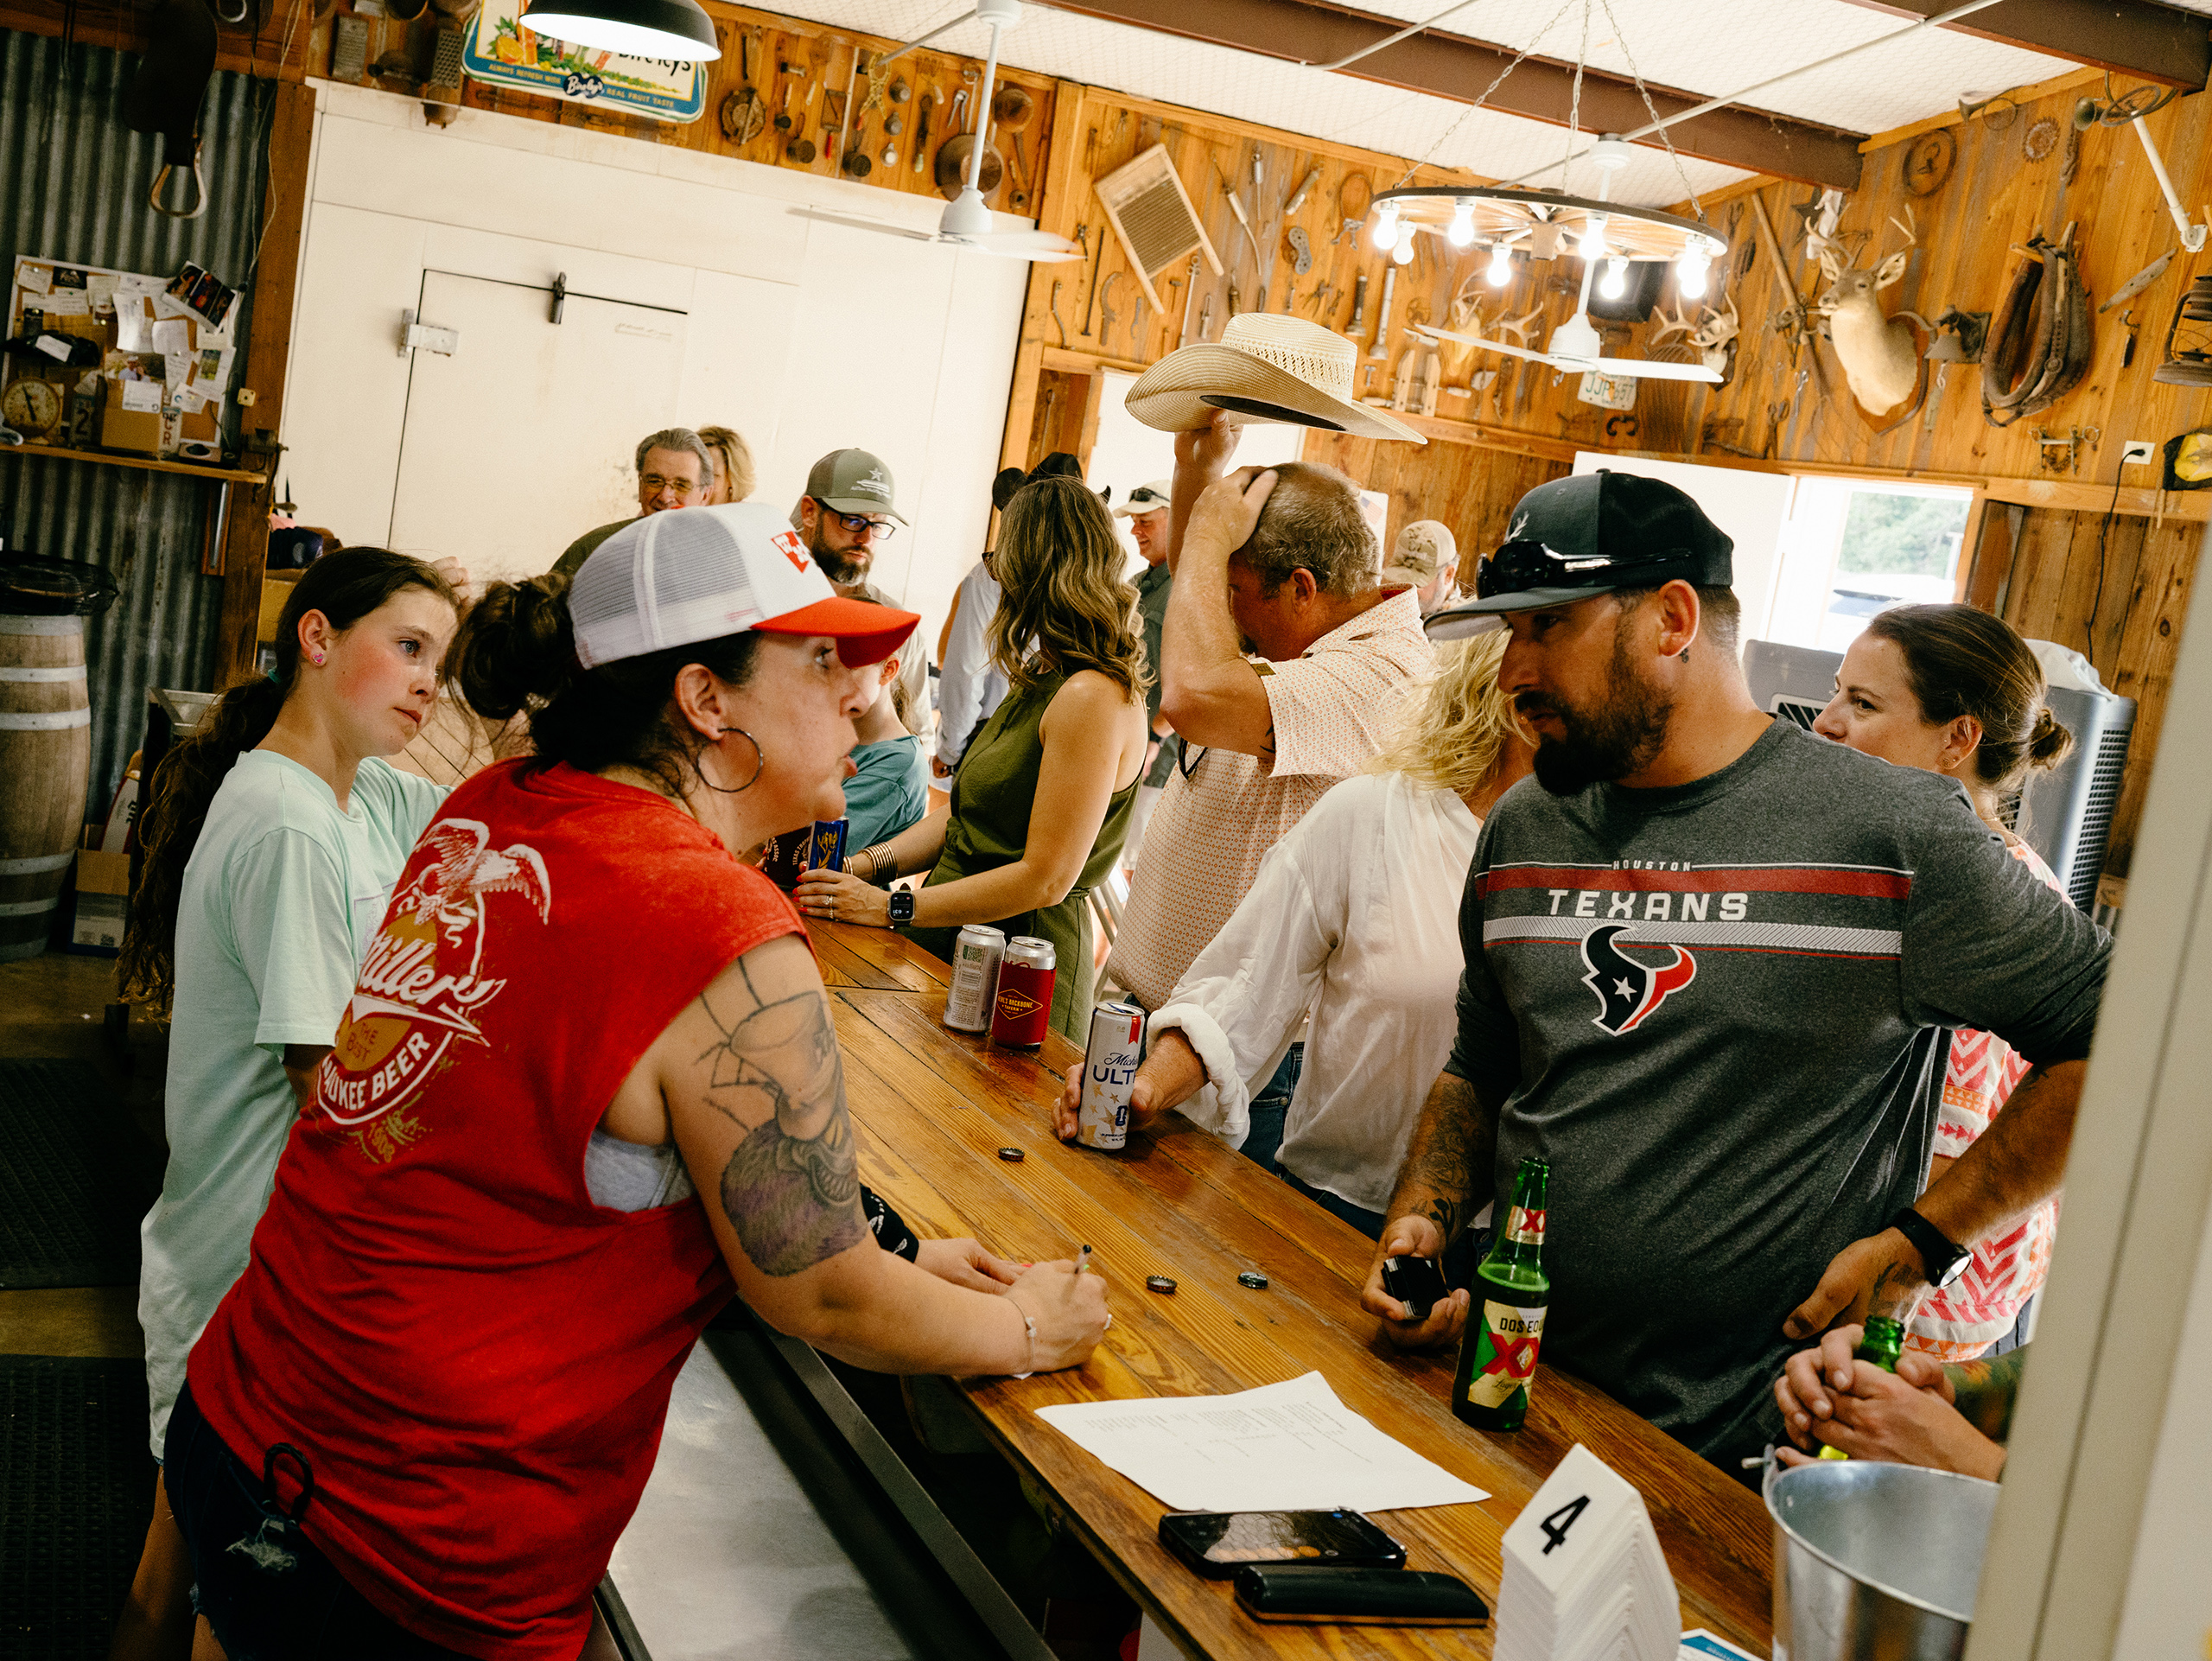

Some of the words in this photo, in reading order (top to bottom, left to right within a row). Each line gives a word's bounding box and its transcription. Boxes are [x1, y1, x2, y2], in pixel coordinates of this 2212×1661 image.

[627, 91, 652, 103] FRUIT
[652, 96, 675, 108] TASTE
[1613, 860, 1691, 872] HOUSTON
[1548, 889, 1749, 921] TEXANS
[1008, 999, 1033, 1009] BACKBONE
[371, 1031, 431, 1102] BEER
[1499, 1317, 1525, 1333] DOS
[1540, 1494, 1591, 1556] 4
